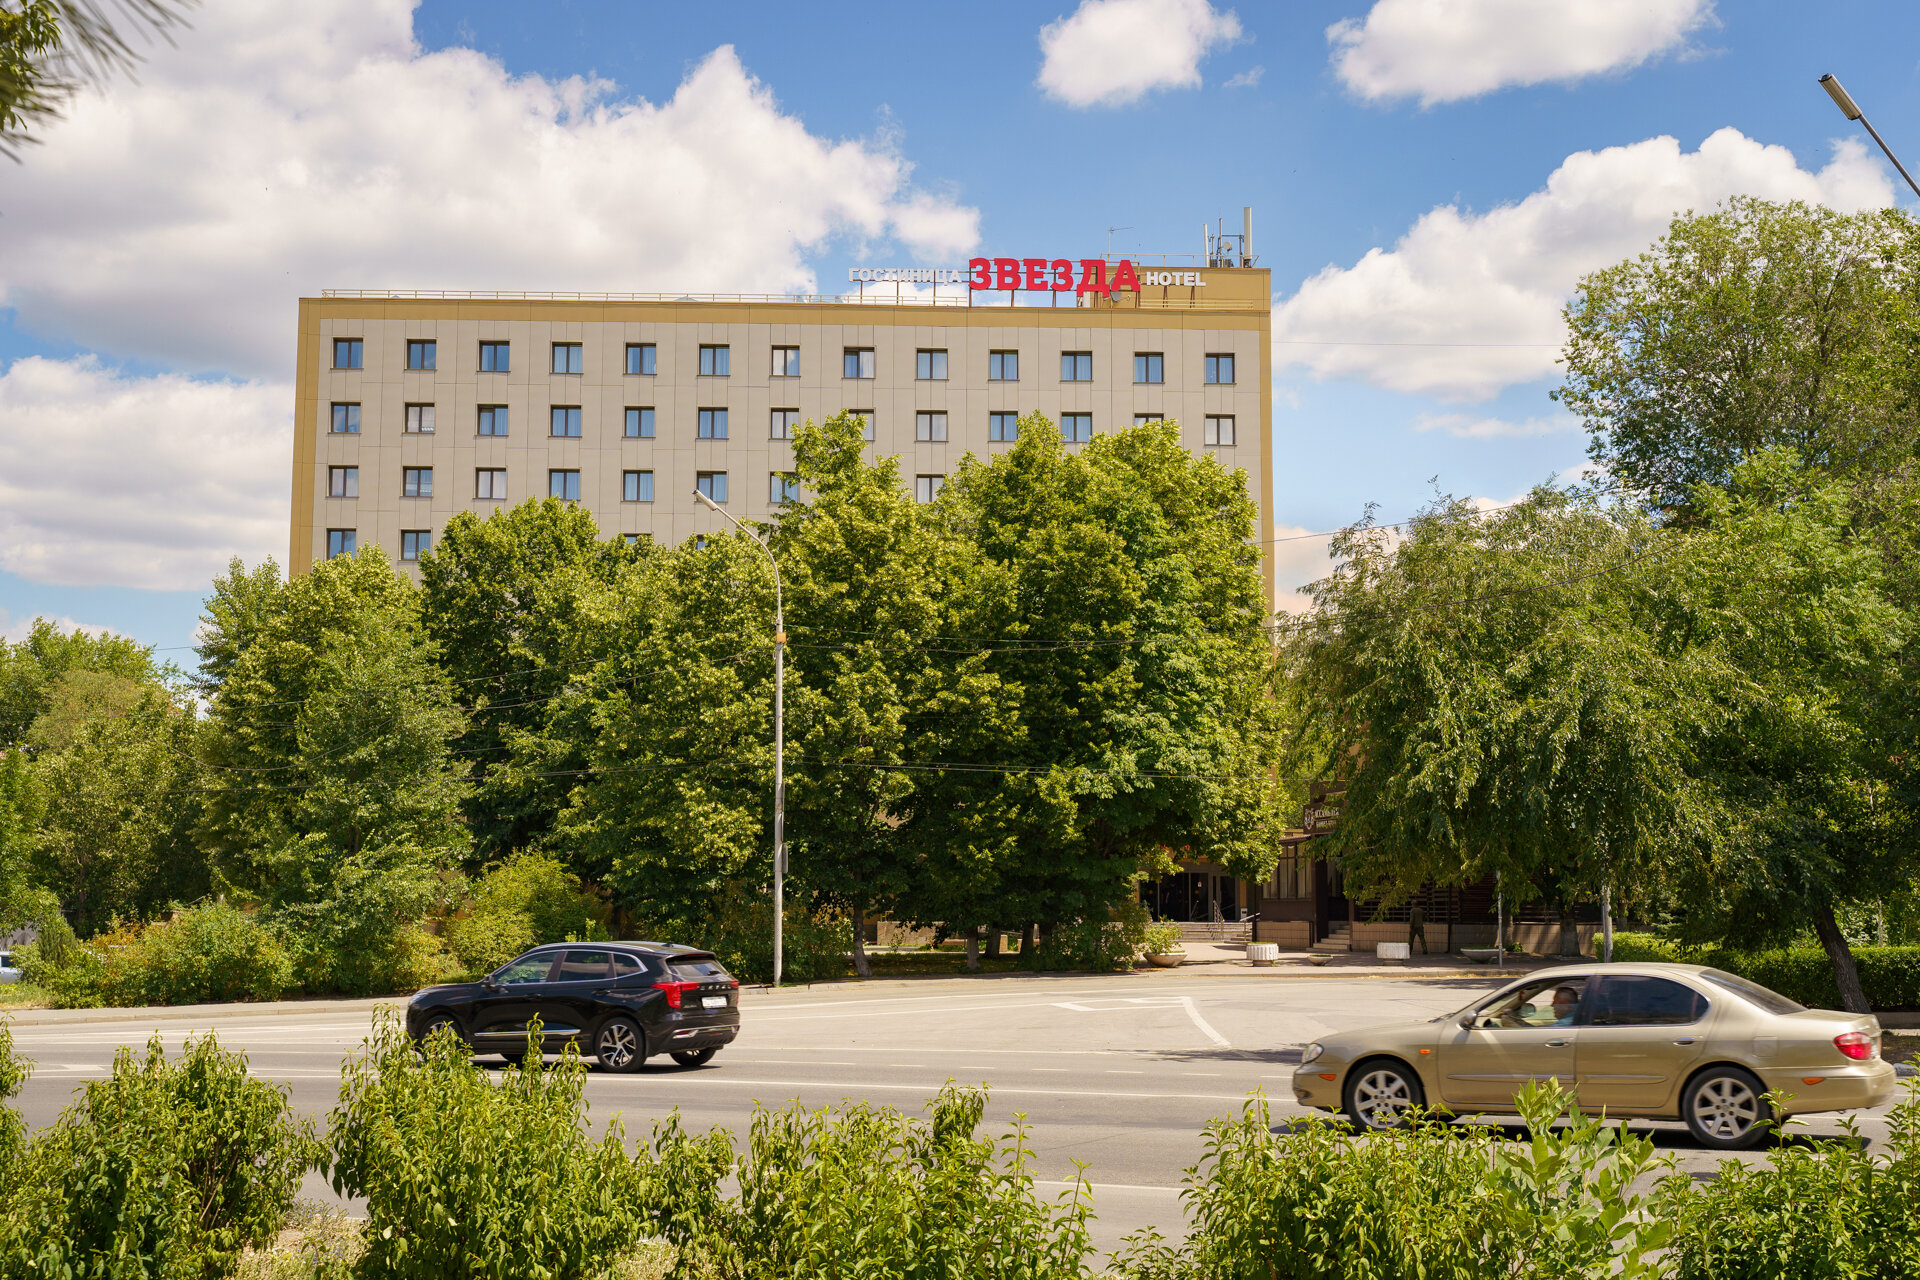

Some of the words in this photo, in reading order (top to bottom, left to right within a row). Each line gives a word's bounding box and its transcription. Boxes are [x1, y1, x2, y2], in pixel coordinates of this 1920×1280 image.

[848, 267, 962, 286] ГОСТИНИЦА
[968, 257, 1141, 297] ЗВЕЗДА
[1146, 271, 1207, 286] HOTEL
